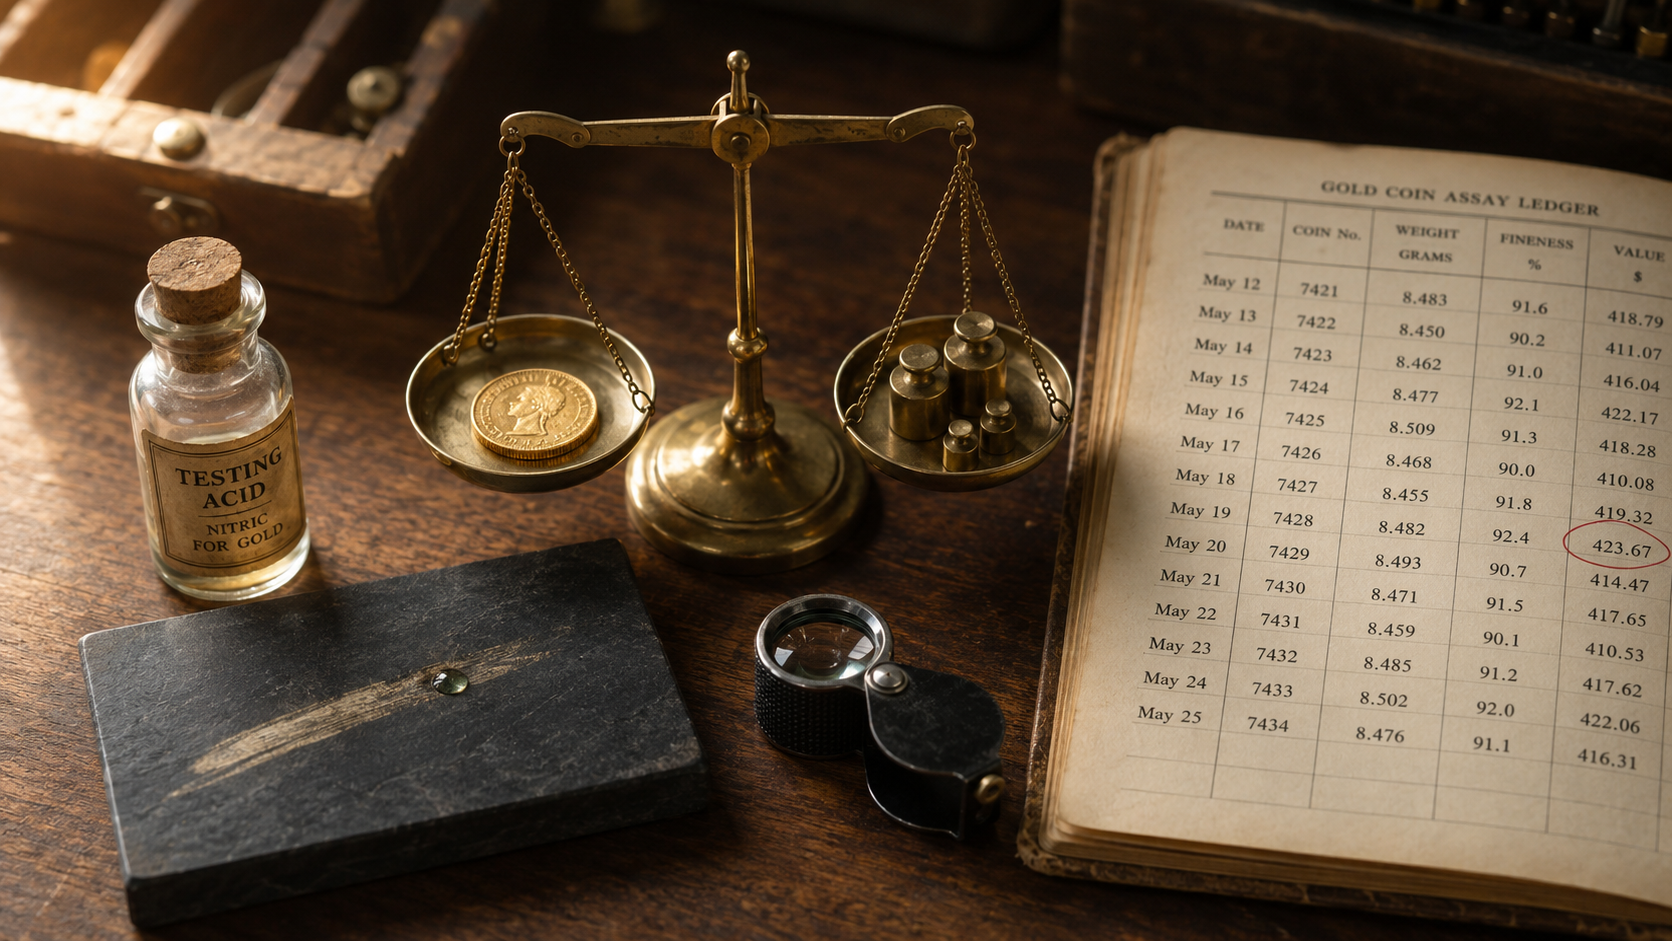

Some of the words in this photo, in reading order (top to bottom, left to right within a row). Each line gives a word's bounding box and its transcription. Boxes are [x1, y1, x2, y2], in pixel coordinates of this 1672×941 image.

[1321, 181, 1377, 196] GOLD
[1386, 187, 1435, 200] COIN
[1445, 192, 1509, 206] ASSAY
[1519, 197, 1598, 216] LEDGER
[1224, 219, 1263, 231] DATE
[1293, 225, 1331, 237] COIN
[1338, 229, 1360, 240] No.
[1396, 225, 1459, 239] WEIGHT
[1500, 233, 1573, 249] FINENESS
[1614, 245, 1664, 262] VALUE
[1399, 250, 1452, 262] GRAMS
[1528, 259, 1541, 270] %
[1634, 271, 1642, 283] $
[1204, 274, 1235, 291] May
[1244, 278, 1260, 290] 12
[1301, 283, 1337, 297] 7421
[1403, 292, 1447, 306] 8.483
[1513, 300, 1547, 314] 91.6
[1608, 311, 1663, 328] 418.79
[1199, 306, 1231, 323] May
[1240, 310, 1256, 322] 13
[1298, 315, 1335, 329] 7422
[1399, 324, 1445, 338] 8.450
[1510, 332, 1544, 346] 90.2
[1606, 342, 1662, 360] 411.07
[1195, 338, 1227, 355] May
[1236, 342, 1252, 354] 14
[1294, 347, 1332, 362] 7423
[1396, 356, 1441, 370] 8.462
[1507, 365, 1542, 378] 91.0
[1604, 375, 1659, 392] 416.04
[1190, 370, 1222, 387] May
[1232, 374, 1248, 386] 15
[1290, 380, 1328, 394] 7424
[1393, 388, 1438, 403] 8.477
[1505, 397, 1538, 411] 92.1
[1602, 407, 1658, 425] 422.17
[1185, 403, 1218, 420] May
[1227, 407, 1243, 419] 16
[1286, 412, 1324, 427] 7425
[1390, 421, 1435, 435] 8.509
[1502, 430, 1536, 443] 91.3
[1599, 440, 1656, 457] 418.28
[176, 446, 282, 486] TESTING
[1181, 436, 1214, 452] May
[1223, 440, 1240, 452] 17
[1282, 445, 1321, 460] 7426
[1386, 454, 1431, 469] 8.468
[1499, 463, 1535, 477] 90.0
[1597, 472, 1654, 491] 410.08
[203, 482, 265, 508] ACID
[1176, 469, 1209, 485] May
[1218, 473, 1235, 485] 18
[1278, 478, 1317, 493] 7427
[1383, 488, 1428, 502] 8.455
[1496, 496, 1531, 510] 91.8
[1594, 505, 1654, 525] 419.32
[193, 540, 229, 552] FOR
[238, 523, 283, 548] GOLD
[206, 513, 268, 535] NITRIC
[1170, 502, 1204, 519] May
[1213, 506, 1230, 518] 19
[1274, 512, 1313, 526] 7428
[1379, 521, 1424, 535] 8.482
[1493, 529, 1529, 544] 92.4
[1593, 540, 1651, 558] 423.67
[1165, 536, 1200, 553] May
[1207, 540, 1226, 552] 20
[1270, 546, 1309, 560] 7429
[1375, 554, 1421, 569] 8.493
[1490, 563, 1526, 577] 90.7
[1590, 574, 1649, 592] 414.47
[1160, 569, 1195, 586] May
[1202, 573, 1219, 586] 21
[1265, 579, 1305, 594] 7430
[1372, 588, 1416, 603] 8.471
[1487, 597, 1523, 612] 91.5
[1588, 608, 1646, 627] 417.65
[1155, 603, 1189, 620] May
[1197, 607, 1216, 620] 22
[1261, 613, 1299, 628] 7431
[1368, 622, 1415, 637] 8.459
[1484, 632, 1518, 647] 90.1
[1586, 643, 1643, 661] 410.53
[1149, 637, 1184, 654] May
[1192, 641, 1210, 654] 23
[1257, 648, 1297, 663] 7432
[1364, 657, 1411, 672] 8.485
[1480, 666, 1517, 681] 91.2
[1583, 678, 1641, 698] 417.62
[1144, 671, 1179, 689] May
[1186, 676, 1206, 689] 24
[1253, 682, 1292, 697] 7433
[1360, 692, 1407, 707] 8.502
[1477, 701, 1514, 717] 92.0
[1580, 713, 1640, 733] 422.06
[1138, 706, 1173, 724] May
[1181, 711, 1201, 723] 25
[1248, 717, 1288, 732] 7434
[1356, 727, 1404, 742] 8.476
[1474, 737, 1509, 752] 91.1
[1578, 749, 1635, 770] 416.31
